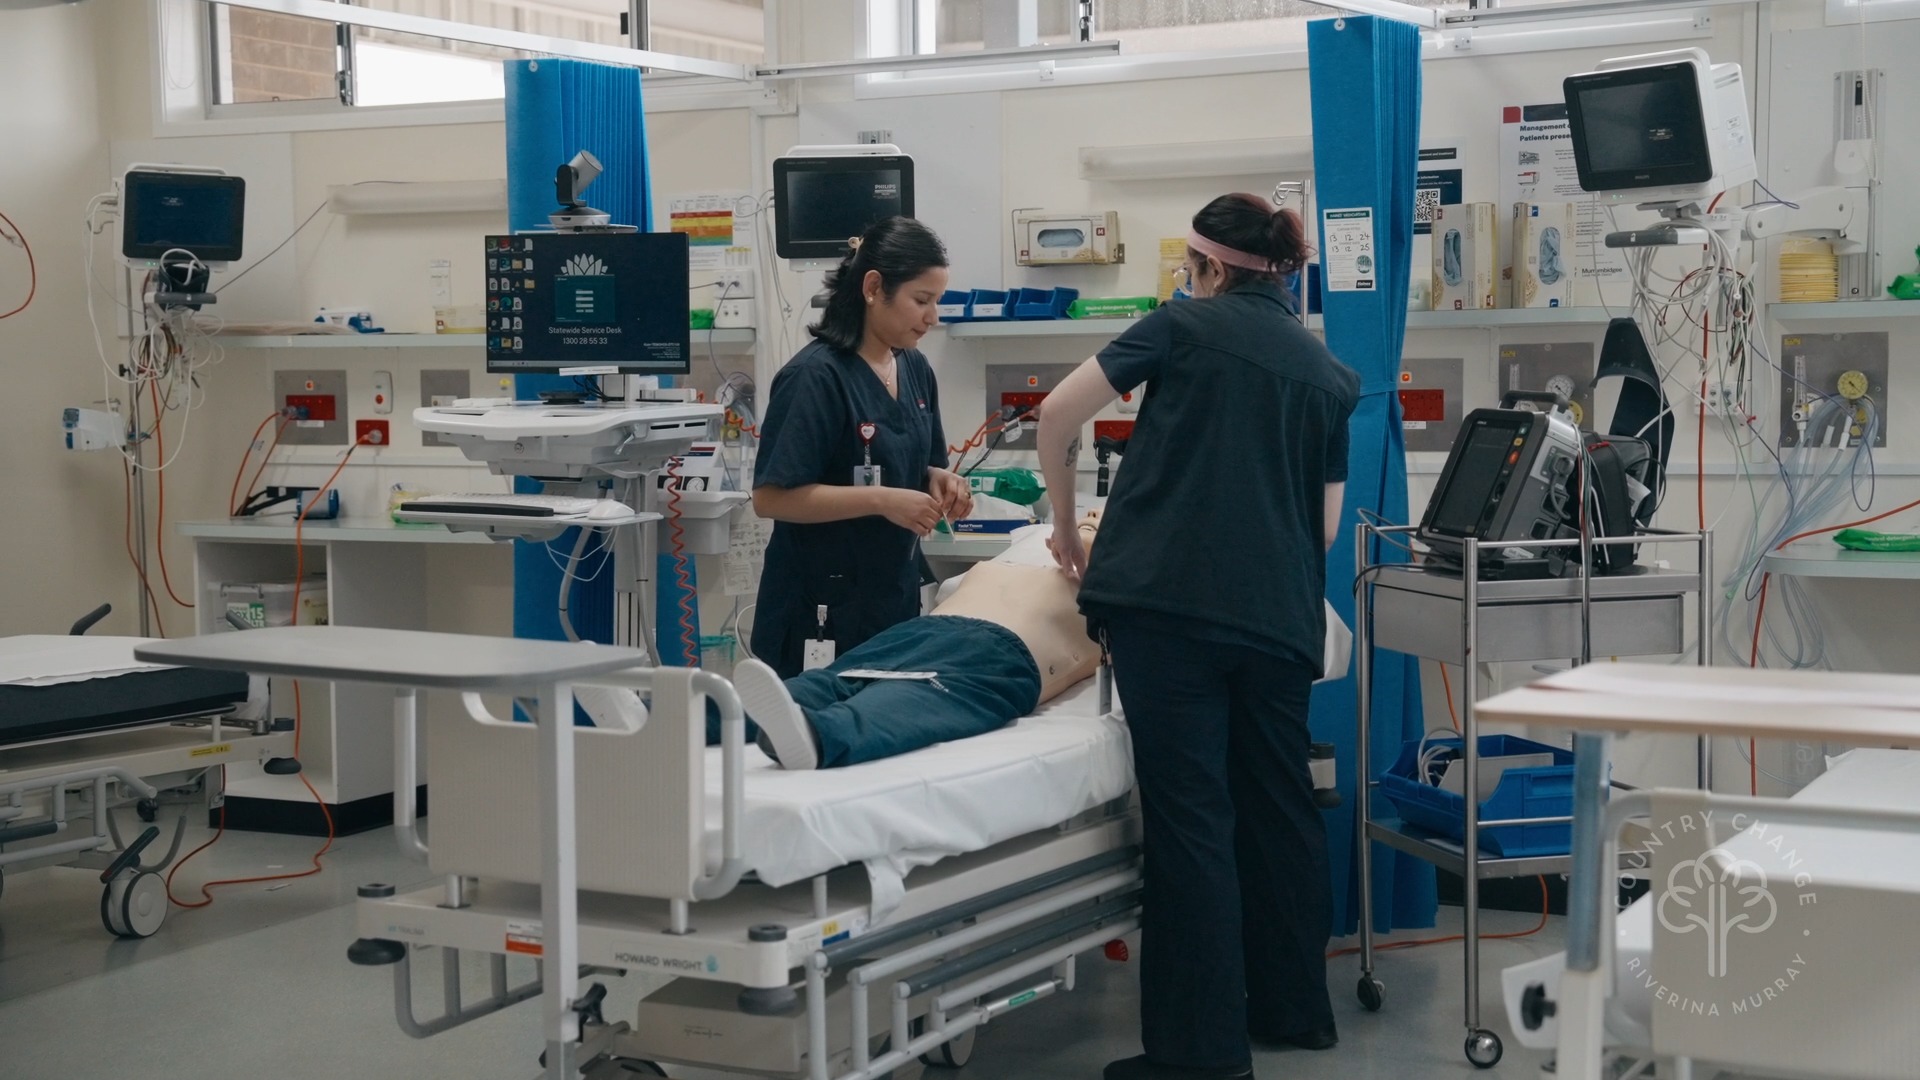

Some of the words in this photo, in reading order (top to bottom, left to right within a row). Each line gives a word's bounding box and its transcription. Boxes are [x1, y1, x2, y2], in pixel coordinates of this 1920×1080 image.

[1520, 123, 1566, 132] Management
[1550, 133, 1572, 141] prese
[1329, 234, 1338, 242] 13
[1359, 232, 1371, 241] 24
[1331, 245, 1339, 253] 13
[1360, 243, 1370, 251] 25
[548, 326, 580, 334] Statewide
[581, 326, 605, 334] Service
[605, 326, 622, 334] Desk
[562, 337, 578, 345] 1300
[579, 337, 588, 345] 28
[588, 337, 598, 345] 55
[598, 337, 608, 345] 33
[250, 607, 264, 619] 15
[251, 620, 265, 628] LTR
[615, 953, 659, 966] HOWARD
[663, 956, 703, 971] WRIGHT
